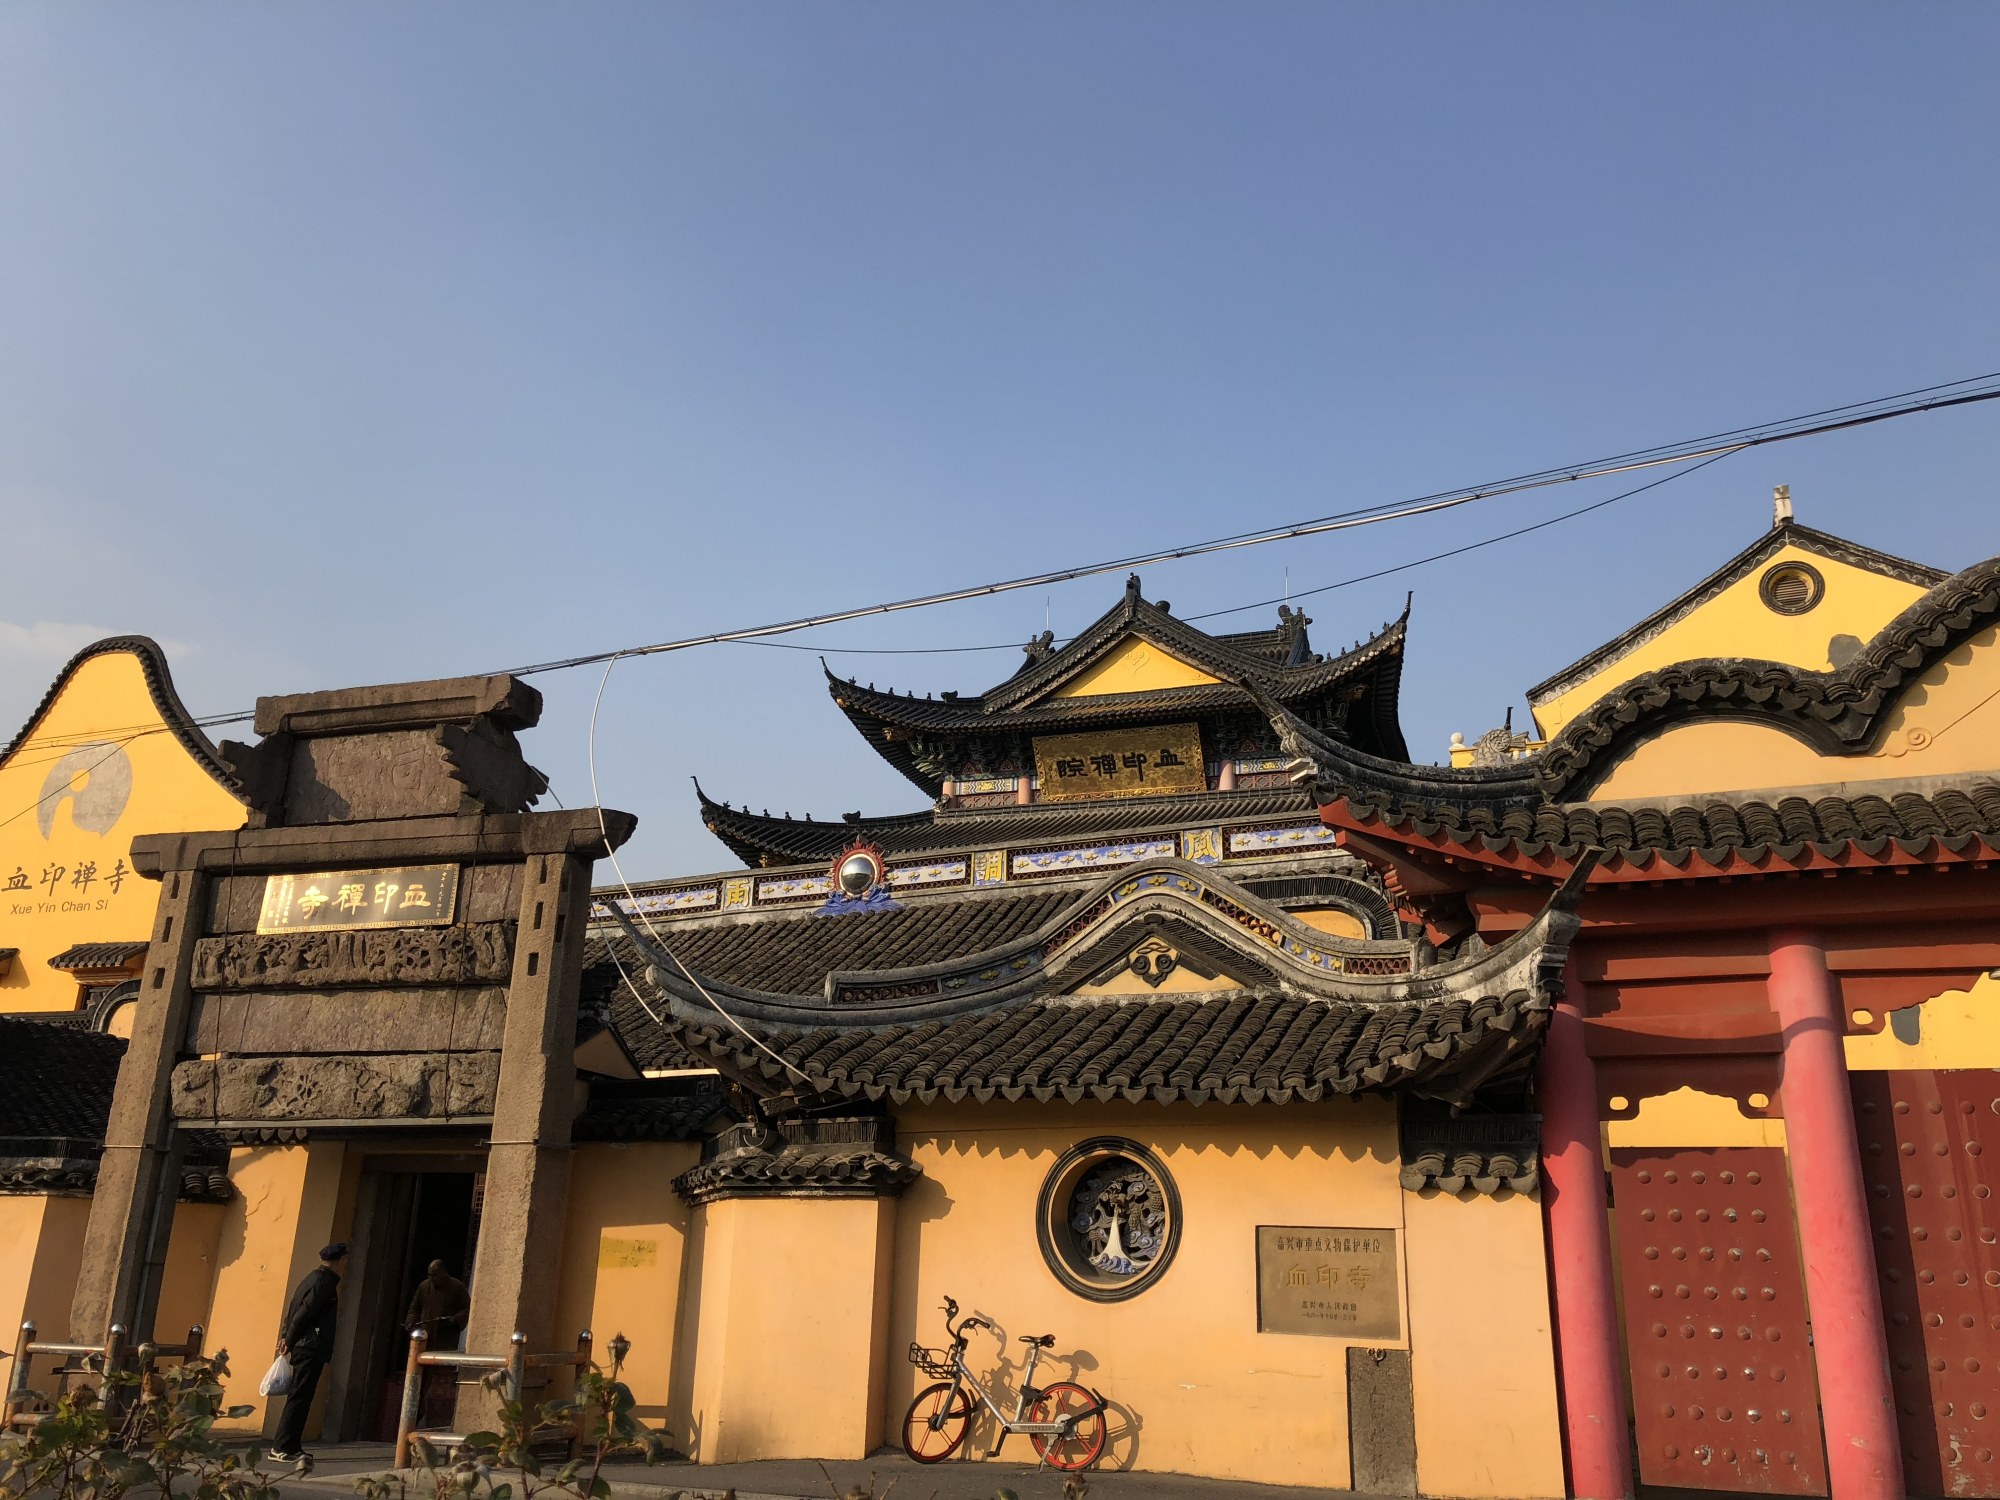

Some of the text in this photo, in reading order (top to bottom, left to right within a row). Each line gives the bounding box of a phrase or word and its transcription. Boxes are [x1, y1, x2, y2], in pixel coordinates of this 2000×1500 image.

[1056, 748, 1186, 783] 血印禪院
[1, 858, 130, 897] 血印禅寺
[10, 899, 109, 915] Xue Yin Chan Si
[296, 881, 432, 920] 血印禪寺
[726, 878, 751, 908] 雨
[1277, 1236, 1382, 1254] 嘉兴市重点文物保护单位
[1286, 1263, 1373, 1292] 血印寺
